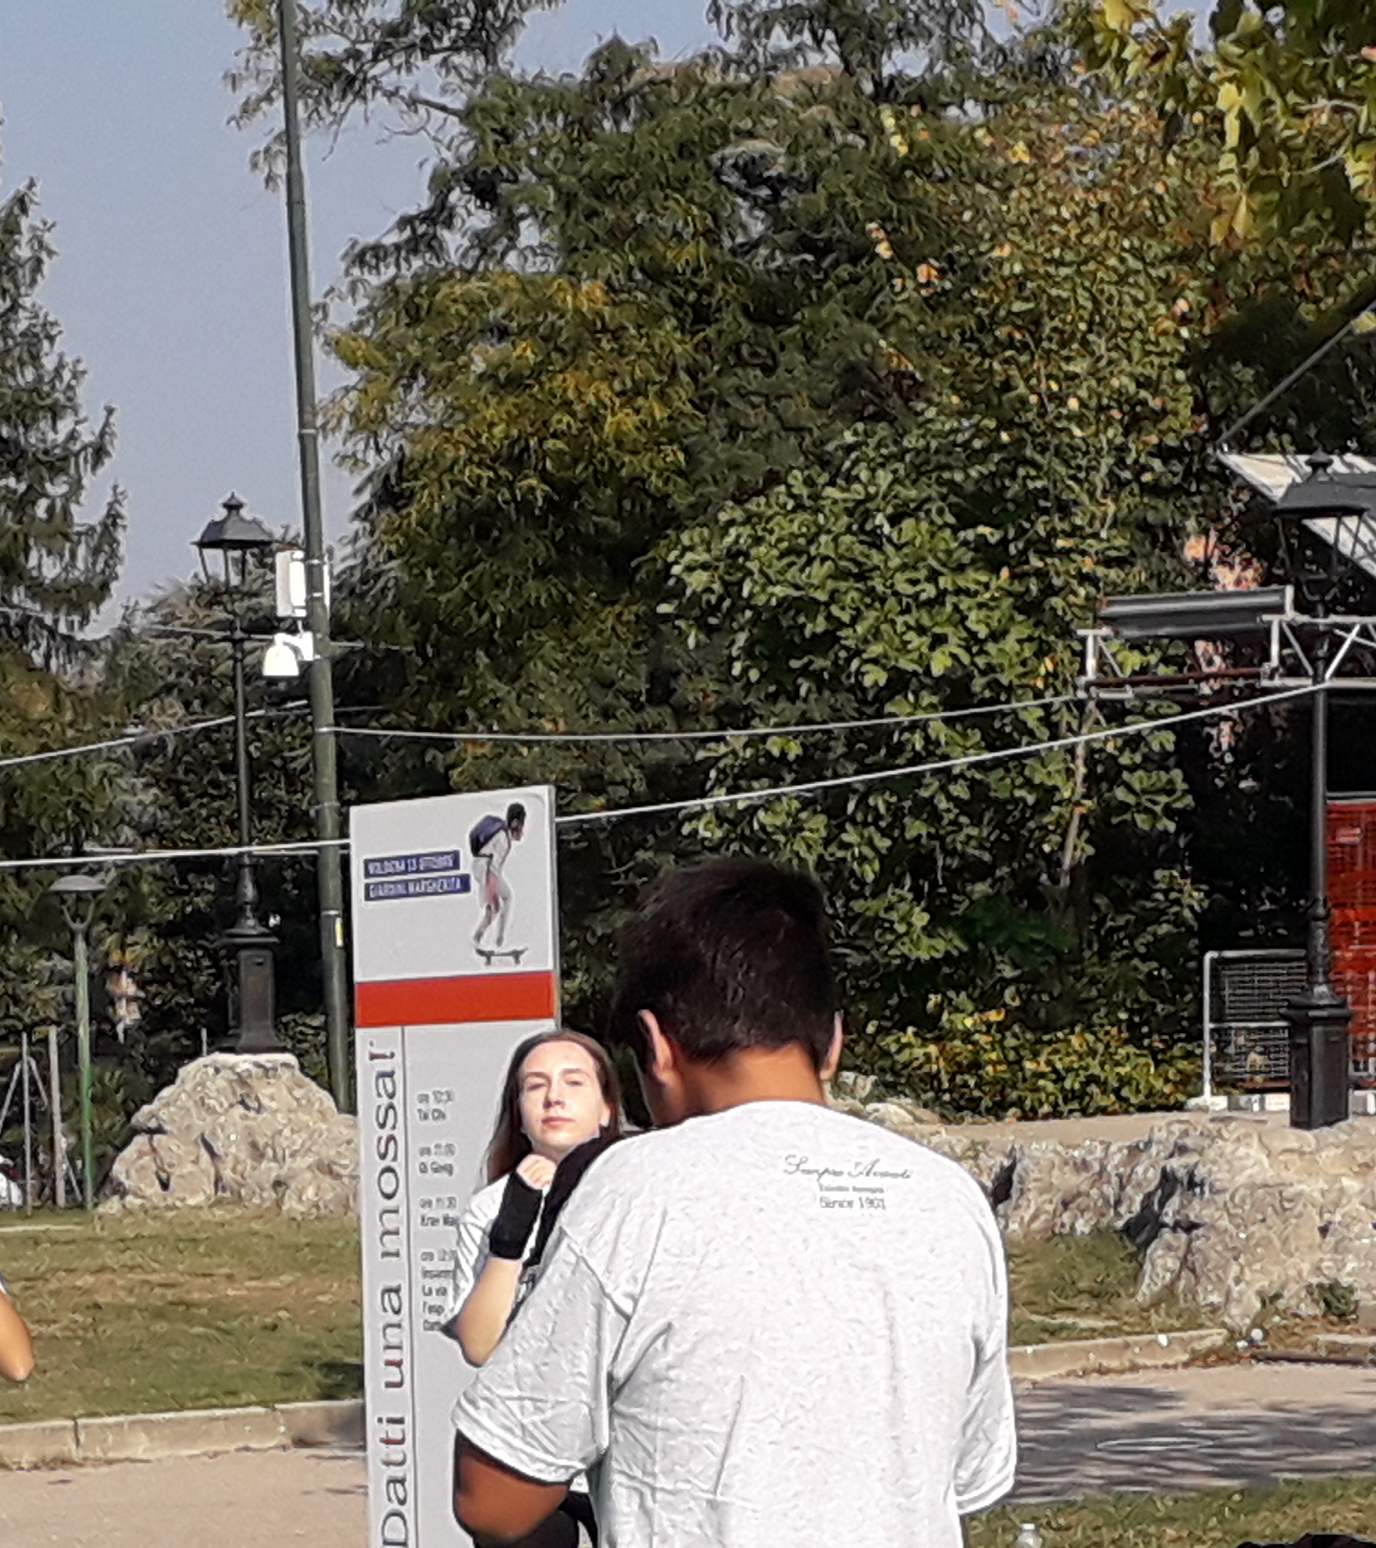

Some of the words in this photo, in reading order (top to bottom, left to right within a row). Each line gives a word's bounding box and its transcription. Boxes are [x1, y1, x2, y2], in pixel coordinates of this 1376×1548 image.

[368, 1050, 401, 1261] mossa!
[380, 1283, 405, 1389] una
[376, 1416, 409, 1548] Datti
